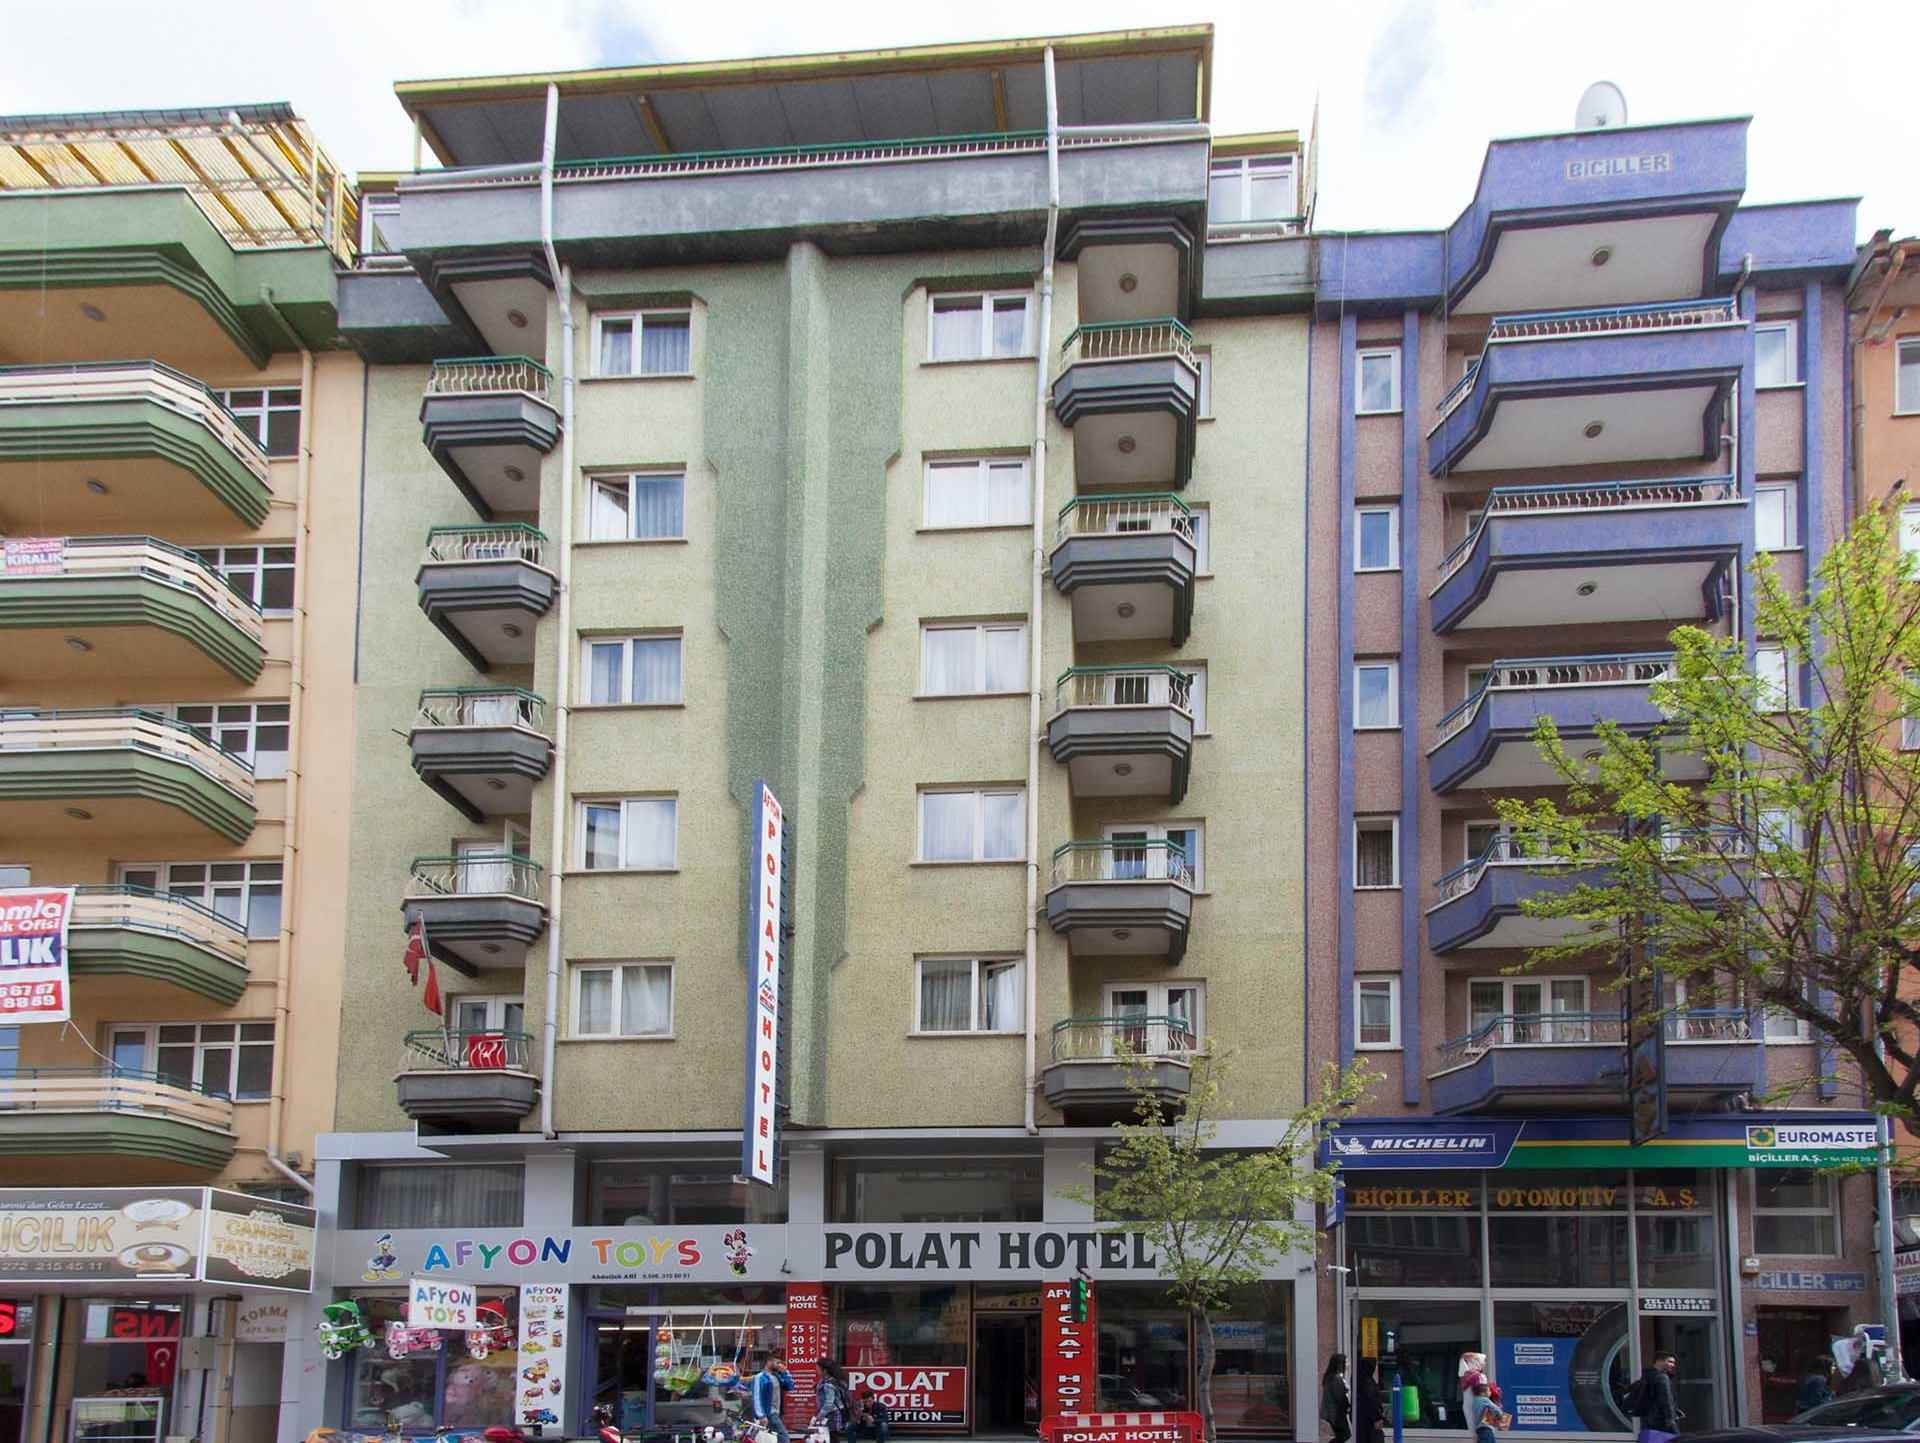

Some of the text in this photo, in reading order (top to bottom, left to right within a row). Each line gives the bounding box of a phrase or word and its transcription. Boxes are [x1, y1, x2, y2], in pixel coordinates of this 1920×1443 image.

[8, 553, 63, 565] KIRALIK
[764, 821, 776, 972] POLAT
[759, 1016, 772, 1171] HOTEL
[1371, 1137, 1486, 1149] MICHELIN
[424, 1237, 702, 1272] AFYON TOYS
[824, 1232, 1157, 1269] POLAT HOTEL
[415, 1286, 473, 1305] AFYON
[525, 1286, 563, 1296] AFYON
[423, 1305, 467, 1324] TOYS
[791, 1325, 805, 1334] 25
[791, 1336, 805, 1344] 50
[791, 1347, 805, 1355] 35
[848, 1371, 950, 1391] POLAT
[873, 1393, 935, 1408] OTEL
[1062, 1430, 1183, 1442] POLAT HOTEL
